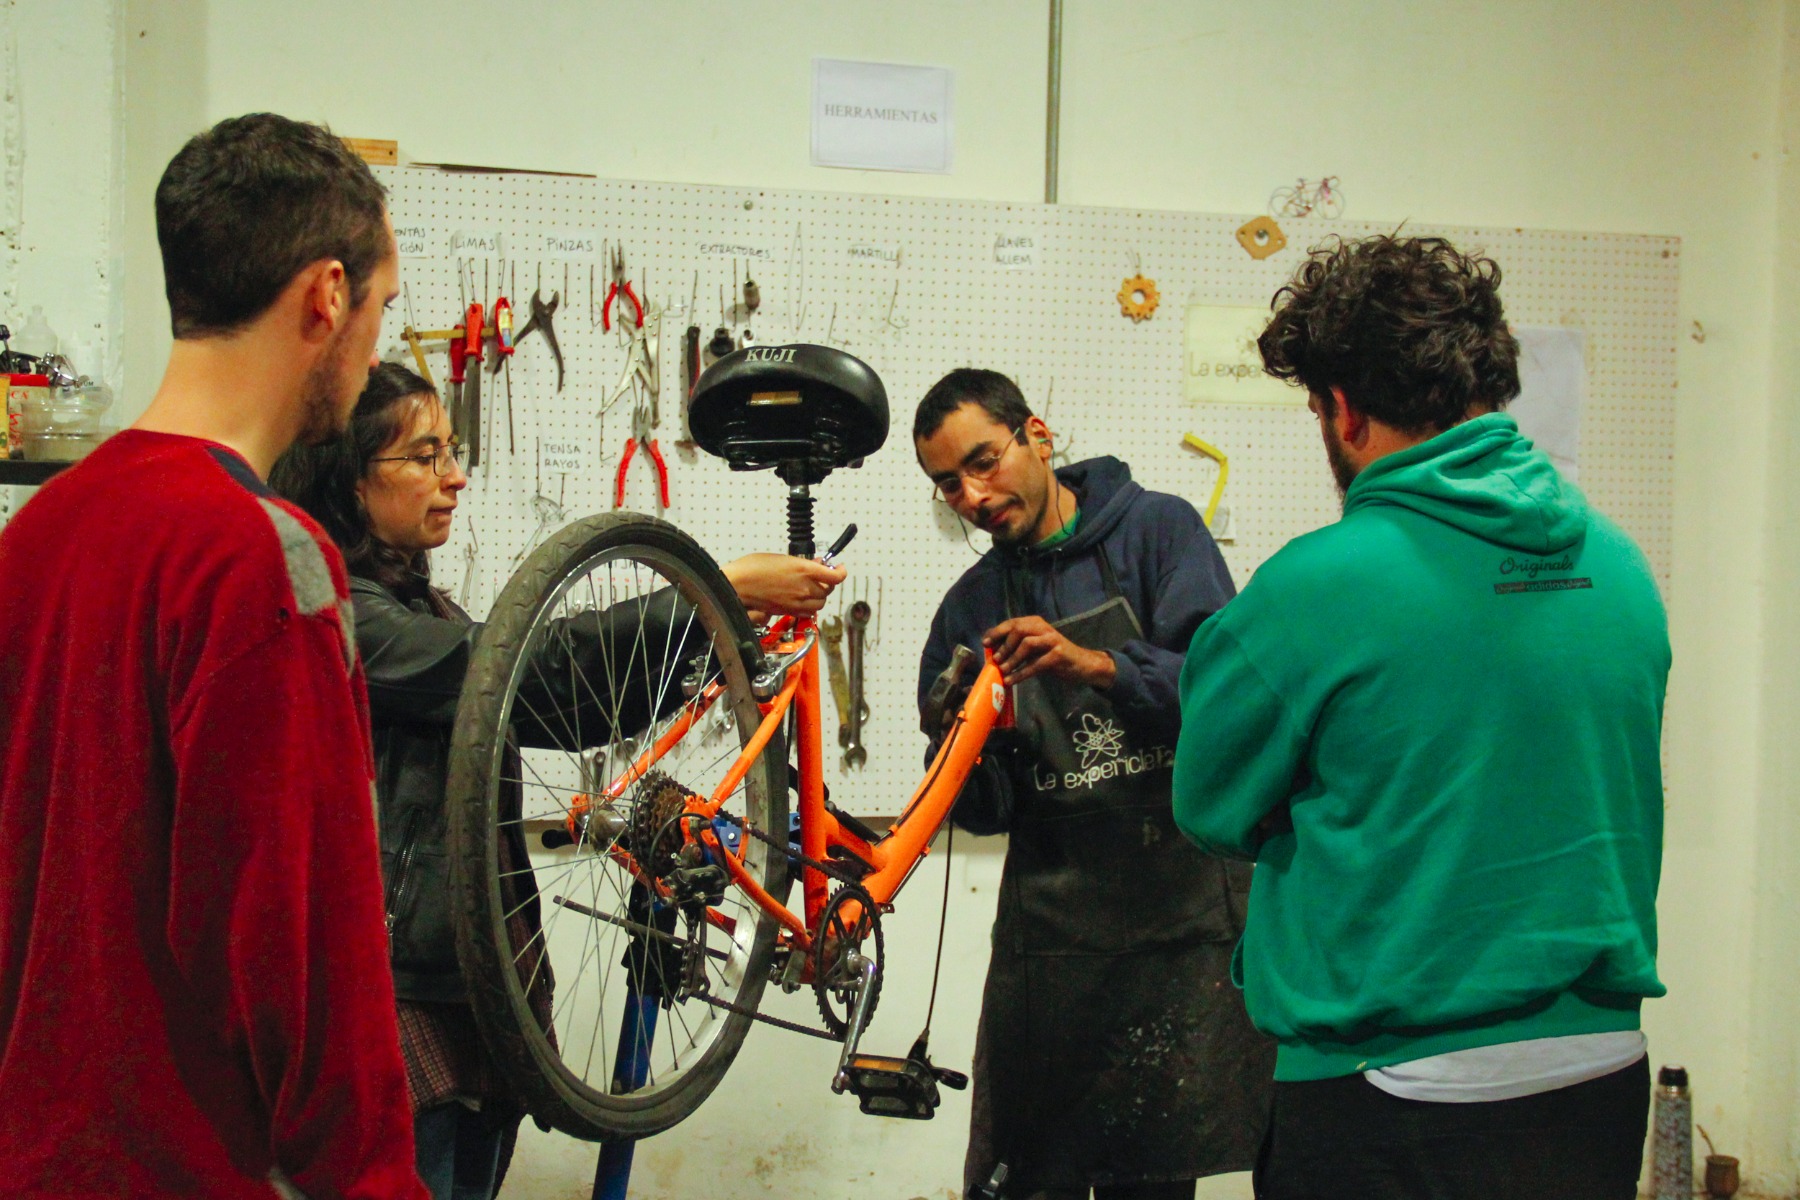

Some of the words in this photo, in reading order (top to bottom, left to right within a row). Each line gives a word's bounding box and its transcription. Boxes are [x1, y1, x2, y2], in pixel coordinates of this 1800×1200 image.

[824, 103, 938, 124] HERRAMIENTAS
[745, 348, 798, 364] KUJI
[1189, 351, 1210, 377] La
[543, 443, 581, 455] TENSA
[544, 458, 580, 469] RAYOS
[1500, 554, 1574, 578] Originals
[1034, 762, 1057, 791] La
